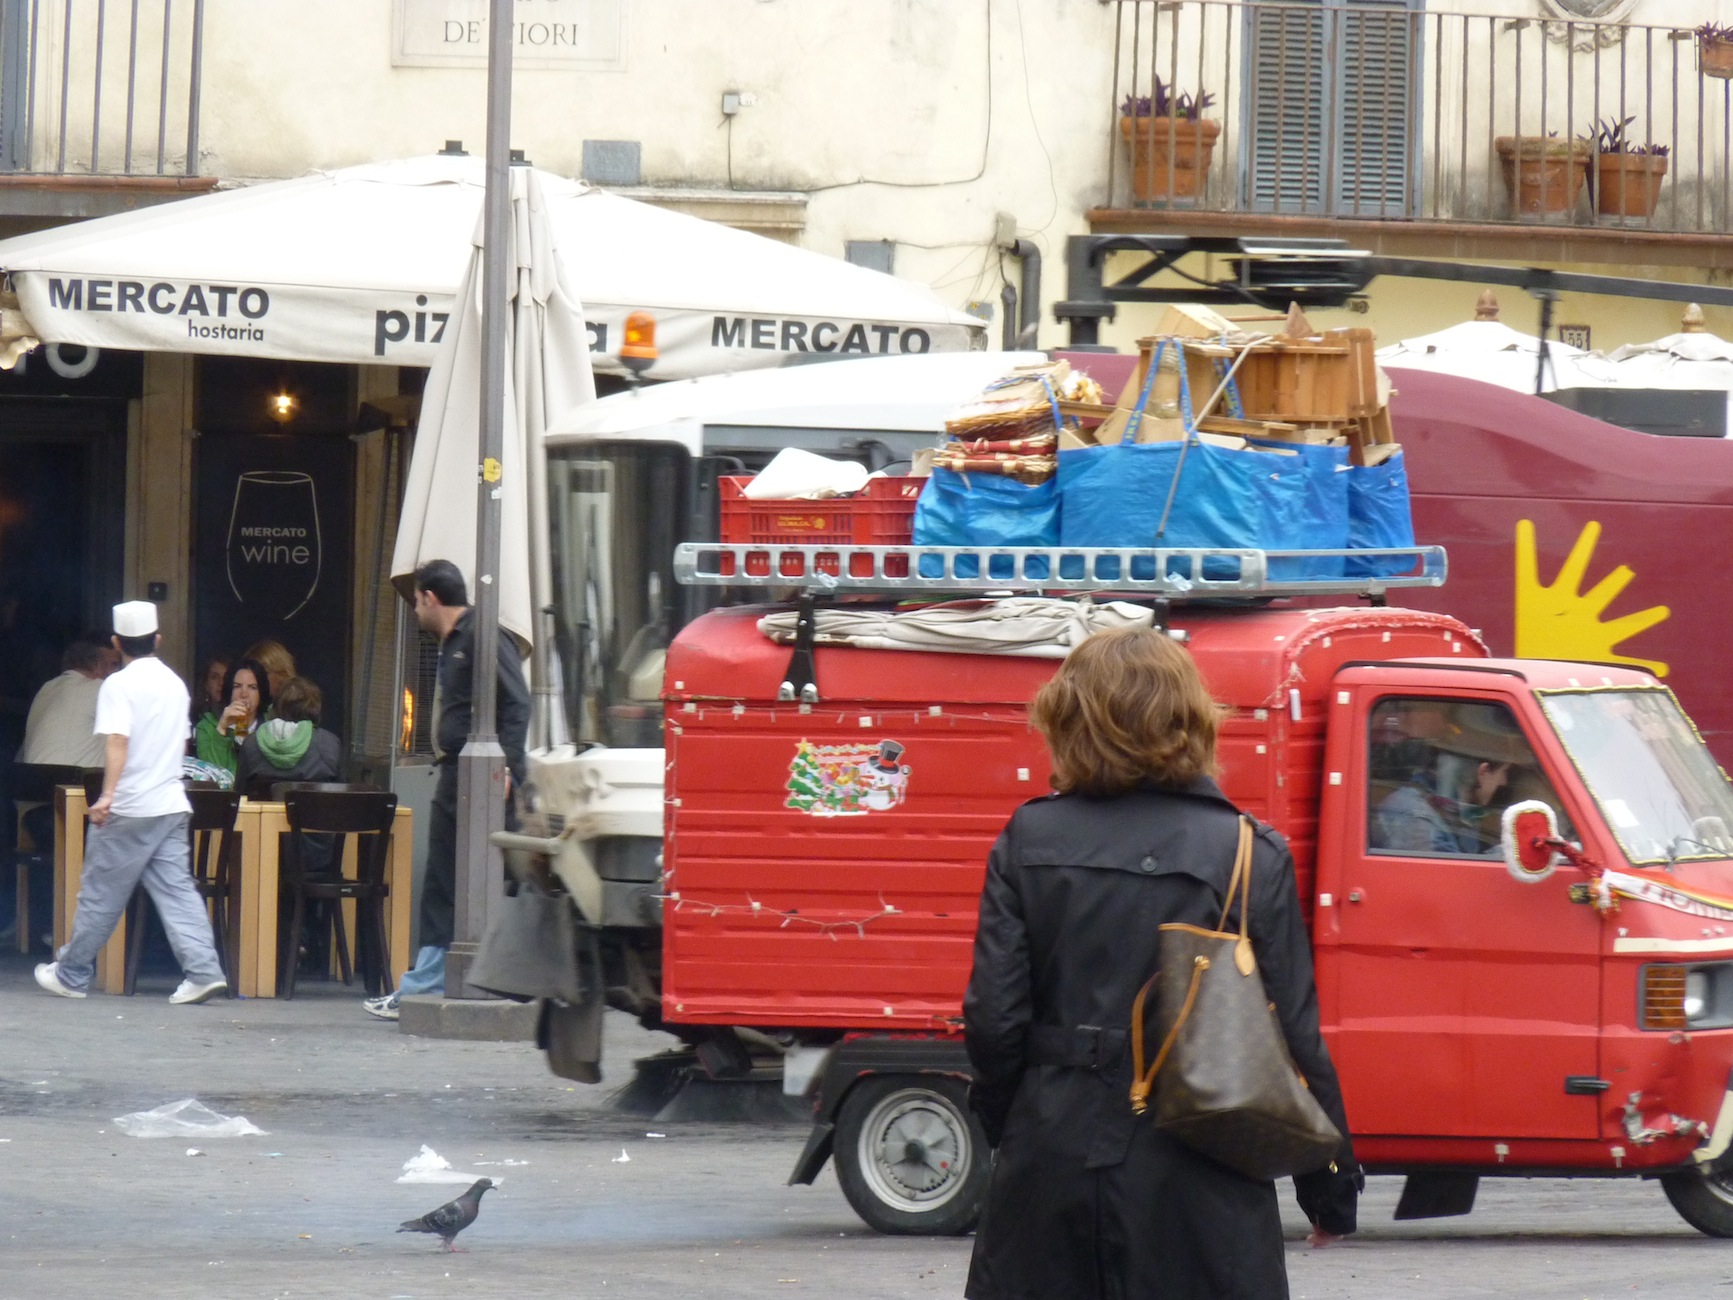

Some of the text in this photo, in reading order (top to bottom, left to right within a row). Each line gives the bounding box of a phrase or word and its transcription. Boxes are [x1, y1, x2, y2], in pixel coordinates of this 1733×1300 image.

[511, 22, 578, 45] IORI
[48, 278, 270, 319] MERCATO
[187, 319, 264, 342] hostaria
[711, 316, 931, 354] MERCATO
[1568, 332, 1583, 349] 55
[241, 527, 307, 537] MERCATO
[241, 539, 310, 564] wine
